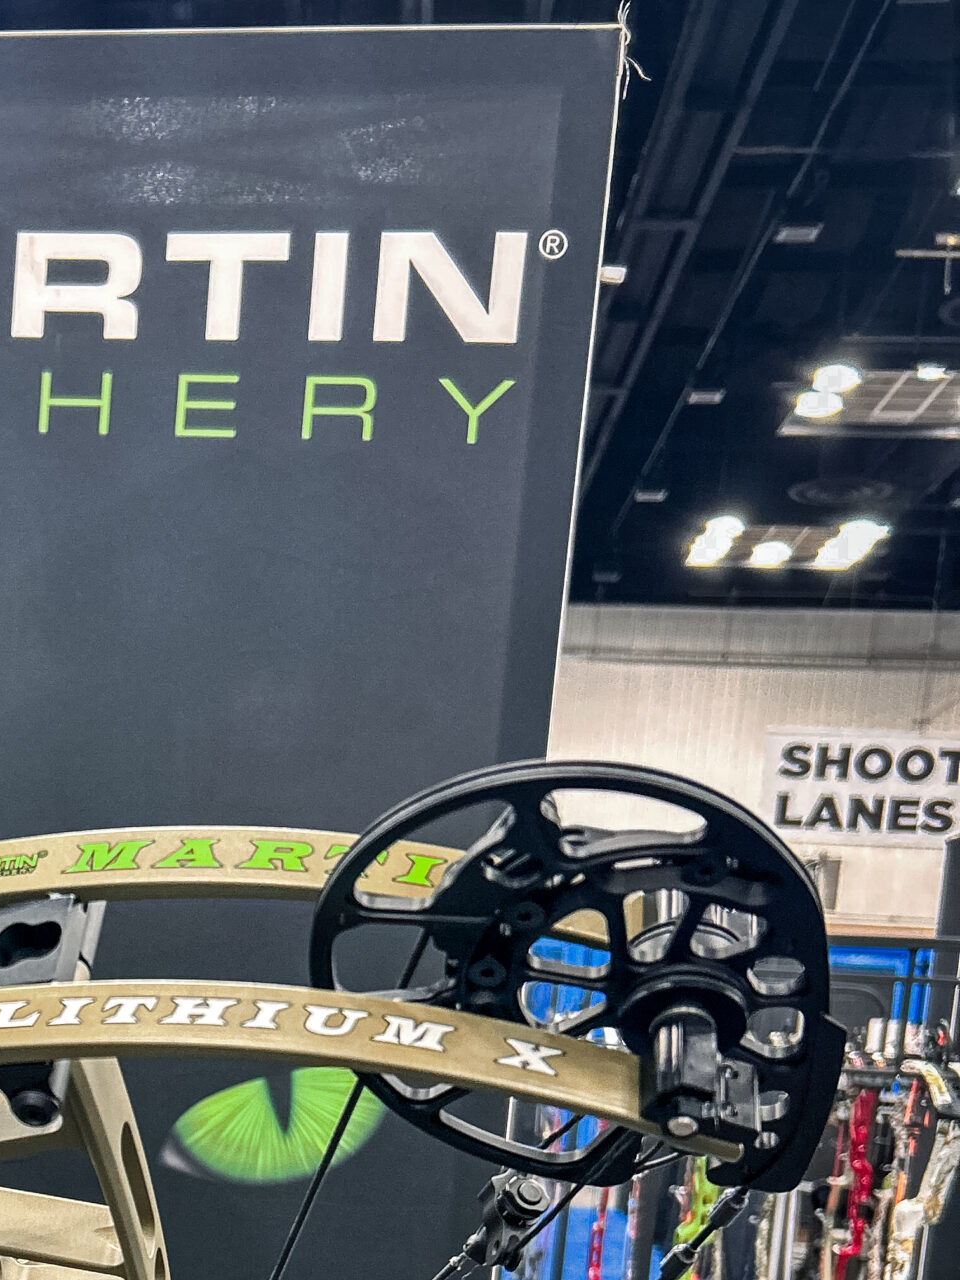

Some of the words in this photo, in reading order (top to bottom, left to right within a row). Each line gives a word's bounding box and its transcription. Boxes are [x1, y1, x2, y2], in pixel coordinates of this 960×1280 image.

[777, 741, 960, 785] SHOOT
[773, 790, 954, 836] LANES
[495, 1036, 566, 1077] X
